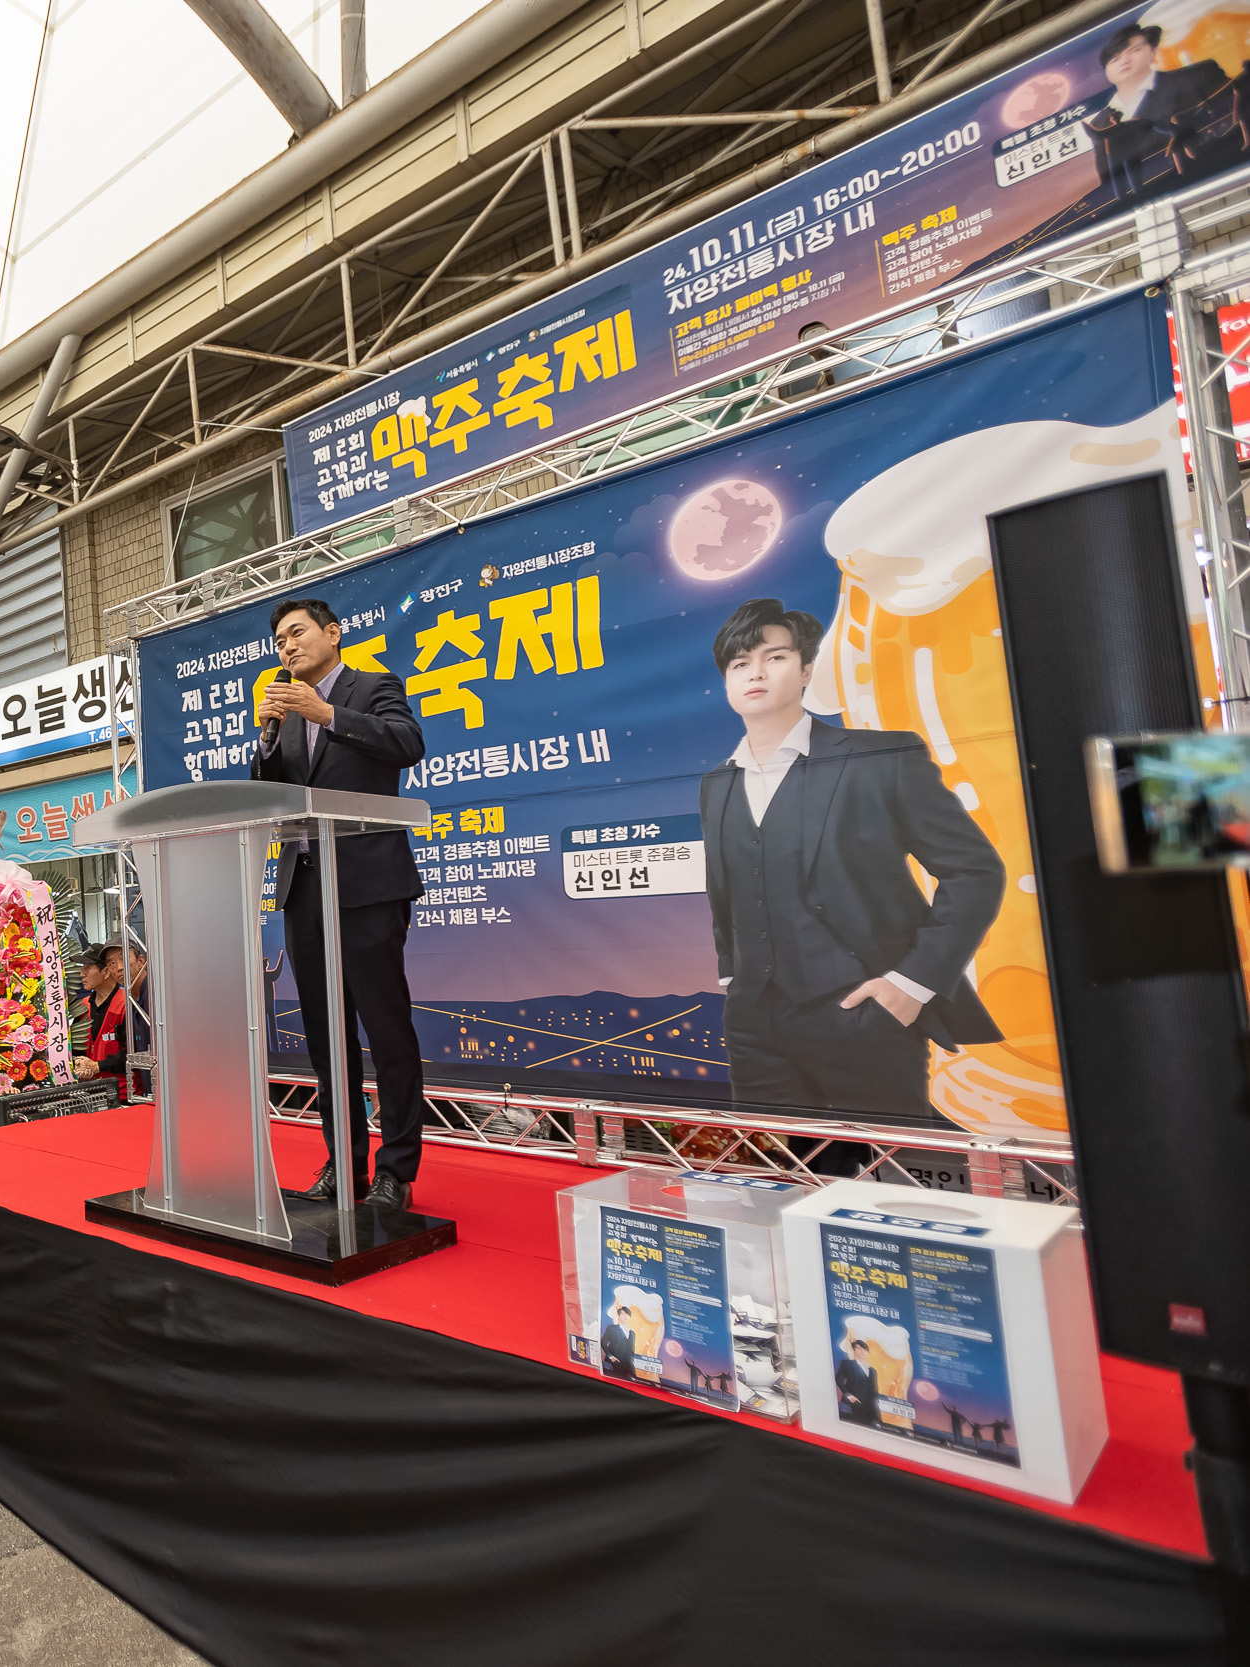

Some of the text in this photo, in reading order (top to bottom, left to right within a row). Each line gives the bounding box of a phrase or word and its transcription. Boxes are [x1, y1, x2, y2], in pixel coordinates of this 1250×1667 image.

[1060, 105, 1087, 124] 가수
[813, 121, 981, 217] 16:00~20:00
[882, 206, 958, 247] 맥주 축제
[884, 246, 907, 261] 고객
[956, 208, 994, 231] 이벤트
[667, 201, 876, 315] 자양전통시장 내
[885, 257, 908, 273] 고객
[935, 225, 983, 251] 노래자랑
[888, 279, 912, 295] 간식
[939, 259, 963, 277] 부스
[703, 303, 733, 326] 감사
[780, 269, 813, 293] 행사
[308, 390, 400, 443] 2024 자양전통시장
[313, 446, 331, 466] 제
[317, 452, 368, 487] 고객과
[317, 469, 390, 512] 함께하는
[502, 541, 596, 579] 자양전통시장조합
[419, 579, 464, 603] 광진구
[340, 606, 386, 635] 울특별시
[176, 657, 205, 679] 2024
[182, 688, 203, 712] 제
[183, 709, 248, 747] 고객과
[578, 727, 610, 766] 내
[459, 806, 506, 836] 축제
[571, 823, 661, 844] 특별 초청 가수
[413, 834, 551, 864] 고객 경품추첨 이벤트
[573, 846, 691, 868] 미스터 트롯 준결승
[445, 864, 475, 883] 참여
[477, 858, 536, 881] 노래자랑
[36, 903, 54, 925] 祝
[416, 906, 512, 928] 간식 체험 부스
[41, 930, 69, 1053] 자양전통시장
[828, 1234, 900, 1254] 2024 자양전통시장
[835, 1299, 900, 1320] 자양전통시장 내
